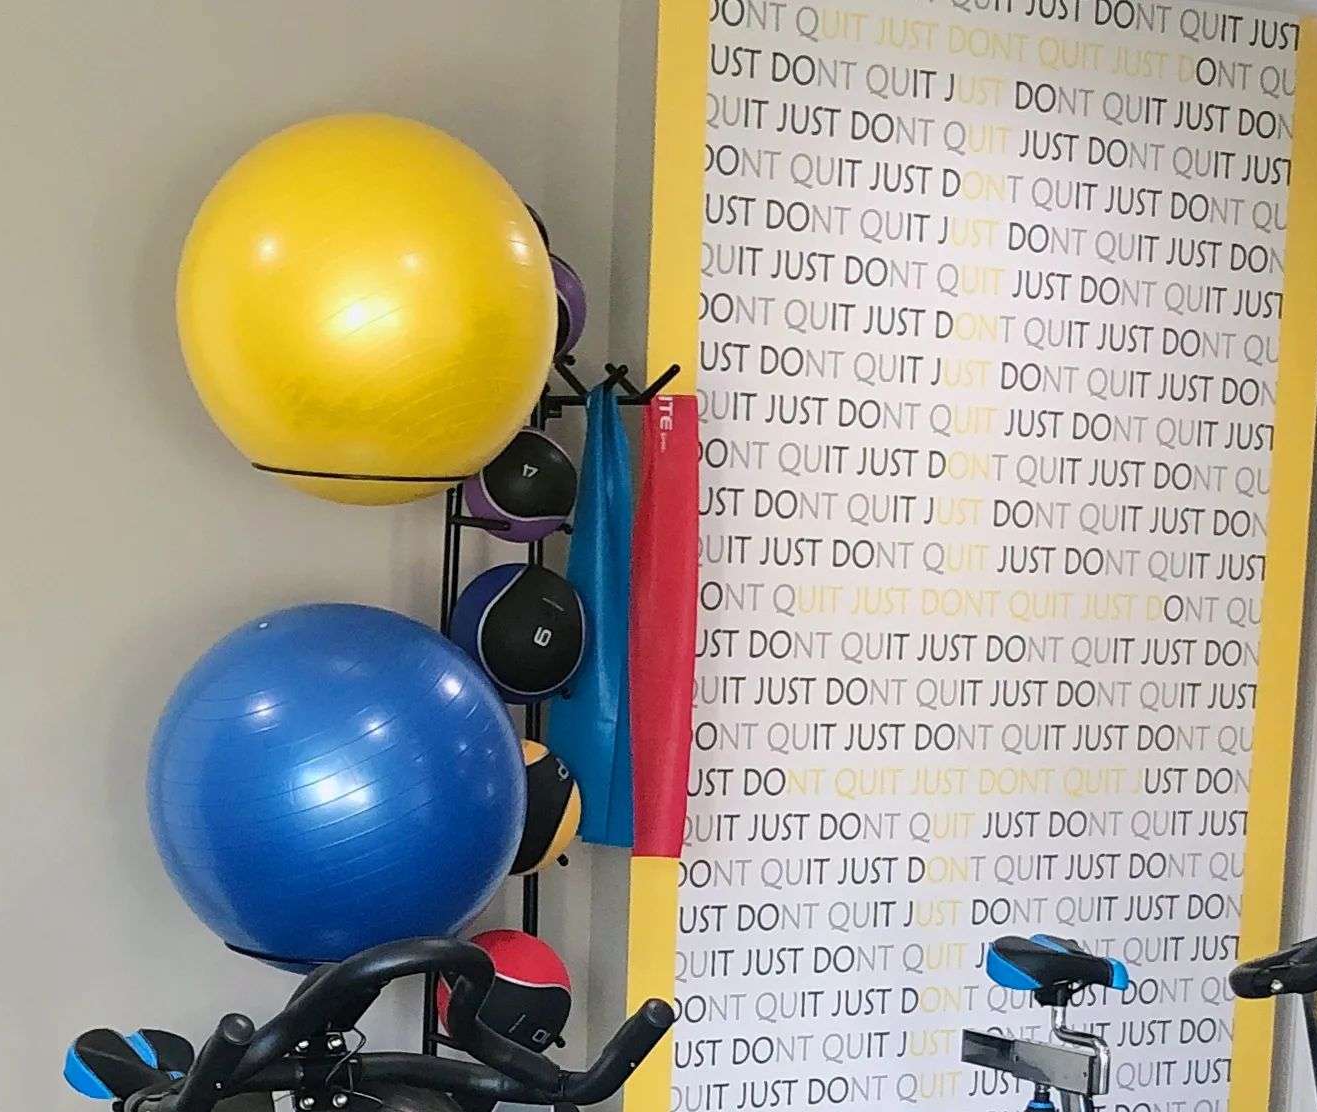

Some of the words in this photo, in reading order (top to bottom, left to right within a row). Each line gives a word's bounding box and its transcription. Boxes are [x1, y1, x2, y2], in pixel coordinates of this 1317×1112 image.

[771, 52, 858, 90] DONT
[866, 64, 938, 100] QUIT
[1015, 81, 1096, 117] DONT
[1102, 92, 1168, 126] QUIT
[1173, 100, 1232, 133] JUST
[790, 153, 863, 189] QUIT
[869, 161, 933, 195] JUST
[942, 168, 1024, 203] DONT
[1032, 177, 1098, 212] QUIT
[1104, 185, 1163, 217] JUST
[1171, 191, 1245, 225] DONT
[770, 249, 836, 283] JUST
[844, 255, 928, 289] DONT
[937, 263, 1005, 297] QUIT
[1012, 270, 1072, 301] JUST
[1080, 275, 1158, 308] DONT
[1165, 282, 1228, 316] QUIT
[760, 345, 846, 379] DONT
[854, 352, 924, 387] QUIT
[1001, 362, 1080, 393] DONT
[1087, 368, 1152, 401] QUIT
[1157, 372, 1214, 403] JUST
[778, 442, 850, 477] QUIT
[856, 447, 920, 477] JUST
[928, 450, 1009, 481] DONT
[1016, 455, 1083, 488] QUIT
[1088, 458, 1146, 488] JUST
[1154, 462, 1228, 492] DONT
[759, 537, 823, 567] JUST
[832, 539, 914, 569] DONT
[923, 542, 990, 575] QUIT
[996, 545, 1057, 574] JUST
[1065, 547, 1141, 576] DONT
[1148, 551, 1211, 582] QUIT
[749, 630, 832, 659] DONT
[841, 632, 910, 664] QUIT
[916, 633, 978, 662] JUST
[986, 635, 1064, 663] DONT
[1071, 636, 1136, 667] QUIT
[1140, 638, 1198, 665] JUST
[754, 676, 817, 705] JUST
[826, 677, 908, 706] DONT
[916, 678, 983, 710] QUIT
[989, 679, 1049, 707] JUST
[1056, 680, 1132, 708] DONT
[1140, 680, 1202, 712] QUIT
[747, 813, 810, 841] JUST
[819, 812, 901, 840] DONT
[909, 812, 976, 844] QUIT
[982, 811, 1041, 839] JUST
[1049, 810, 1123, 838] DONT
[1131, 810, 1193, 841] QUIT
[737, 902, 820, 932] DONT
[828, 901, 897, 933] QUIT
[972, 898, 1048, 925] DONT
[1056, 896, 1119, 927] QUIT
[1124, 894, 1180, 922] JUST
[755, 990, 825, 1023] QUIT
[831, 988, 893, 1017] JUST
[901, 984, 979, 1014] DONT
[732, 1034, 814, 1065] DONT
[822, 1031, 890, 1064] QUIT
[1116, 1019, 1172, 1047] JUST
[737, 1079, 799, 1109] JUST
[808, 1075, 888, 1105] DONT
[1115, 1060, 1178, 1091] QUIT
